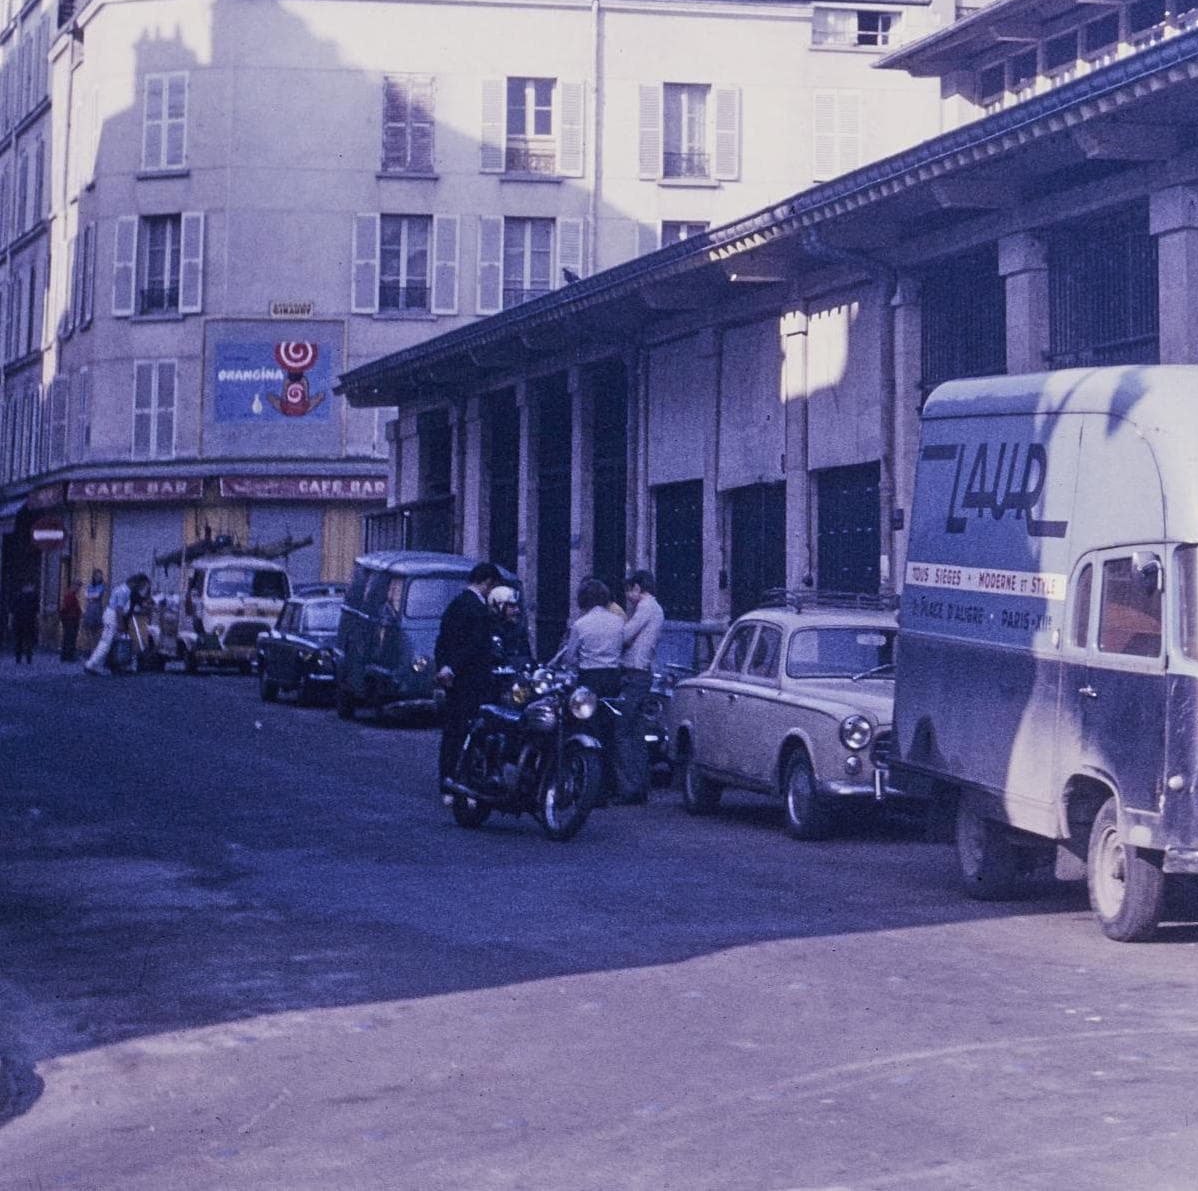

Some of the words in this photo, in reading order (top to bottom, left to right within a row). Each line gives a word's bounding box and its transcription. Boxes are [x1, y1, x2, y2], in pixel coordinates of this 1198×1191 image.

[218, 367, 284, 381] ORANGINA
[935, 568, 962, 586] SIEGES
[979, 572, 1017, 592] MODERNE
[1031, 576, 1056, 595] STYLE
